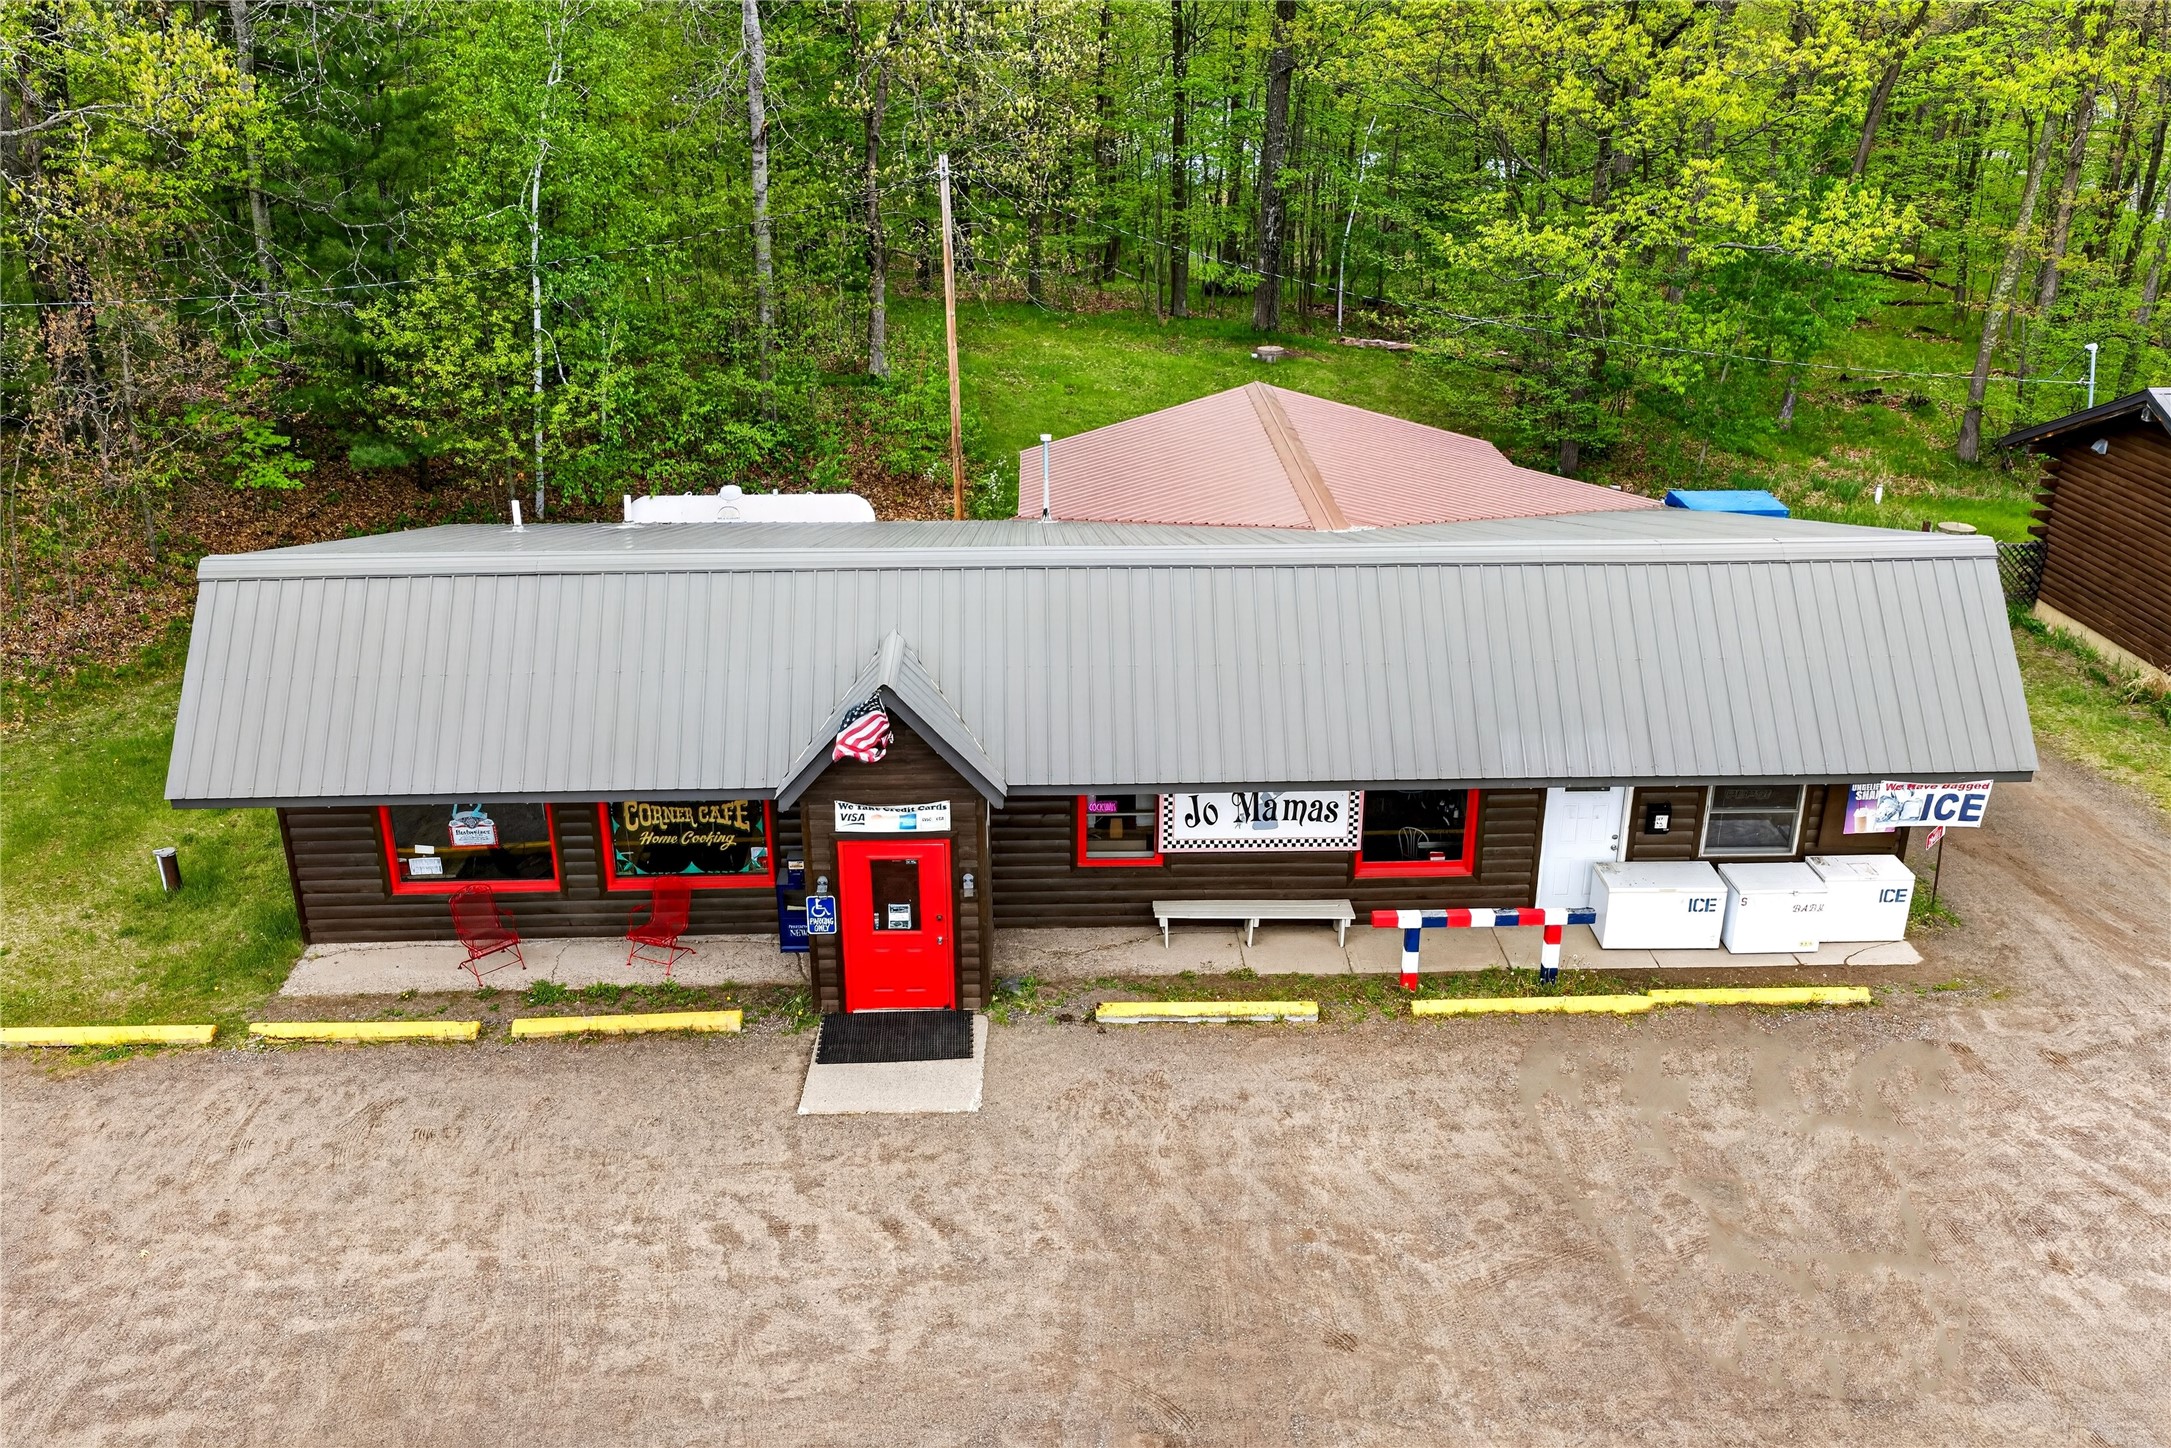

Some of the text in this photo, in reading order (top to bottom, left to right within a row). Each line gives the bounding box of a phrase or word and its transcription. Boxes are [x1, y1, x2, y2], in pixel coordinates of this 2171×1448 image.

[1885, 783, 1903, 791] We
[623, 800, 750, 832] CORNER CAFE
[1185, 792, 1339, 828] Jo Mamas
[1919, 793, 1986, 822] ICE
[840, 813, 865, 822] VISA
[640, 831, 737, 851] Home Cooking
[1879, 888, 1908, 903] ICE
[1687, 898, 1718, 913] ICE
